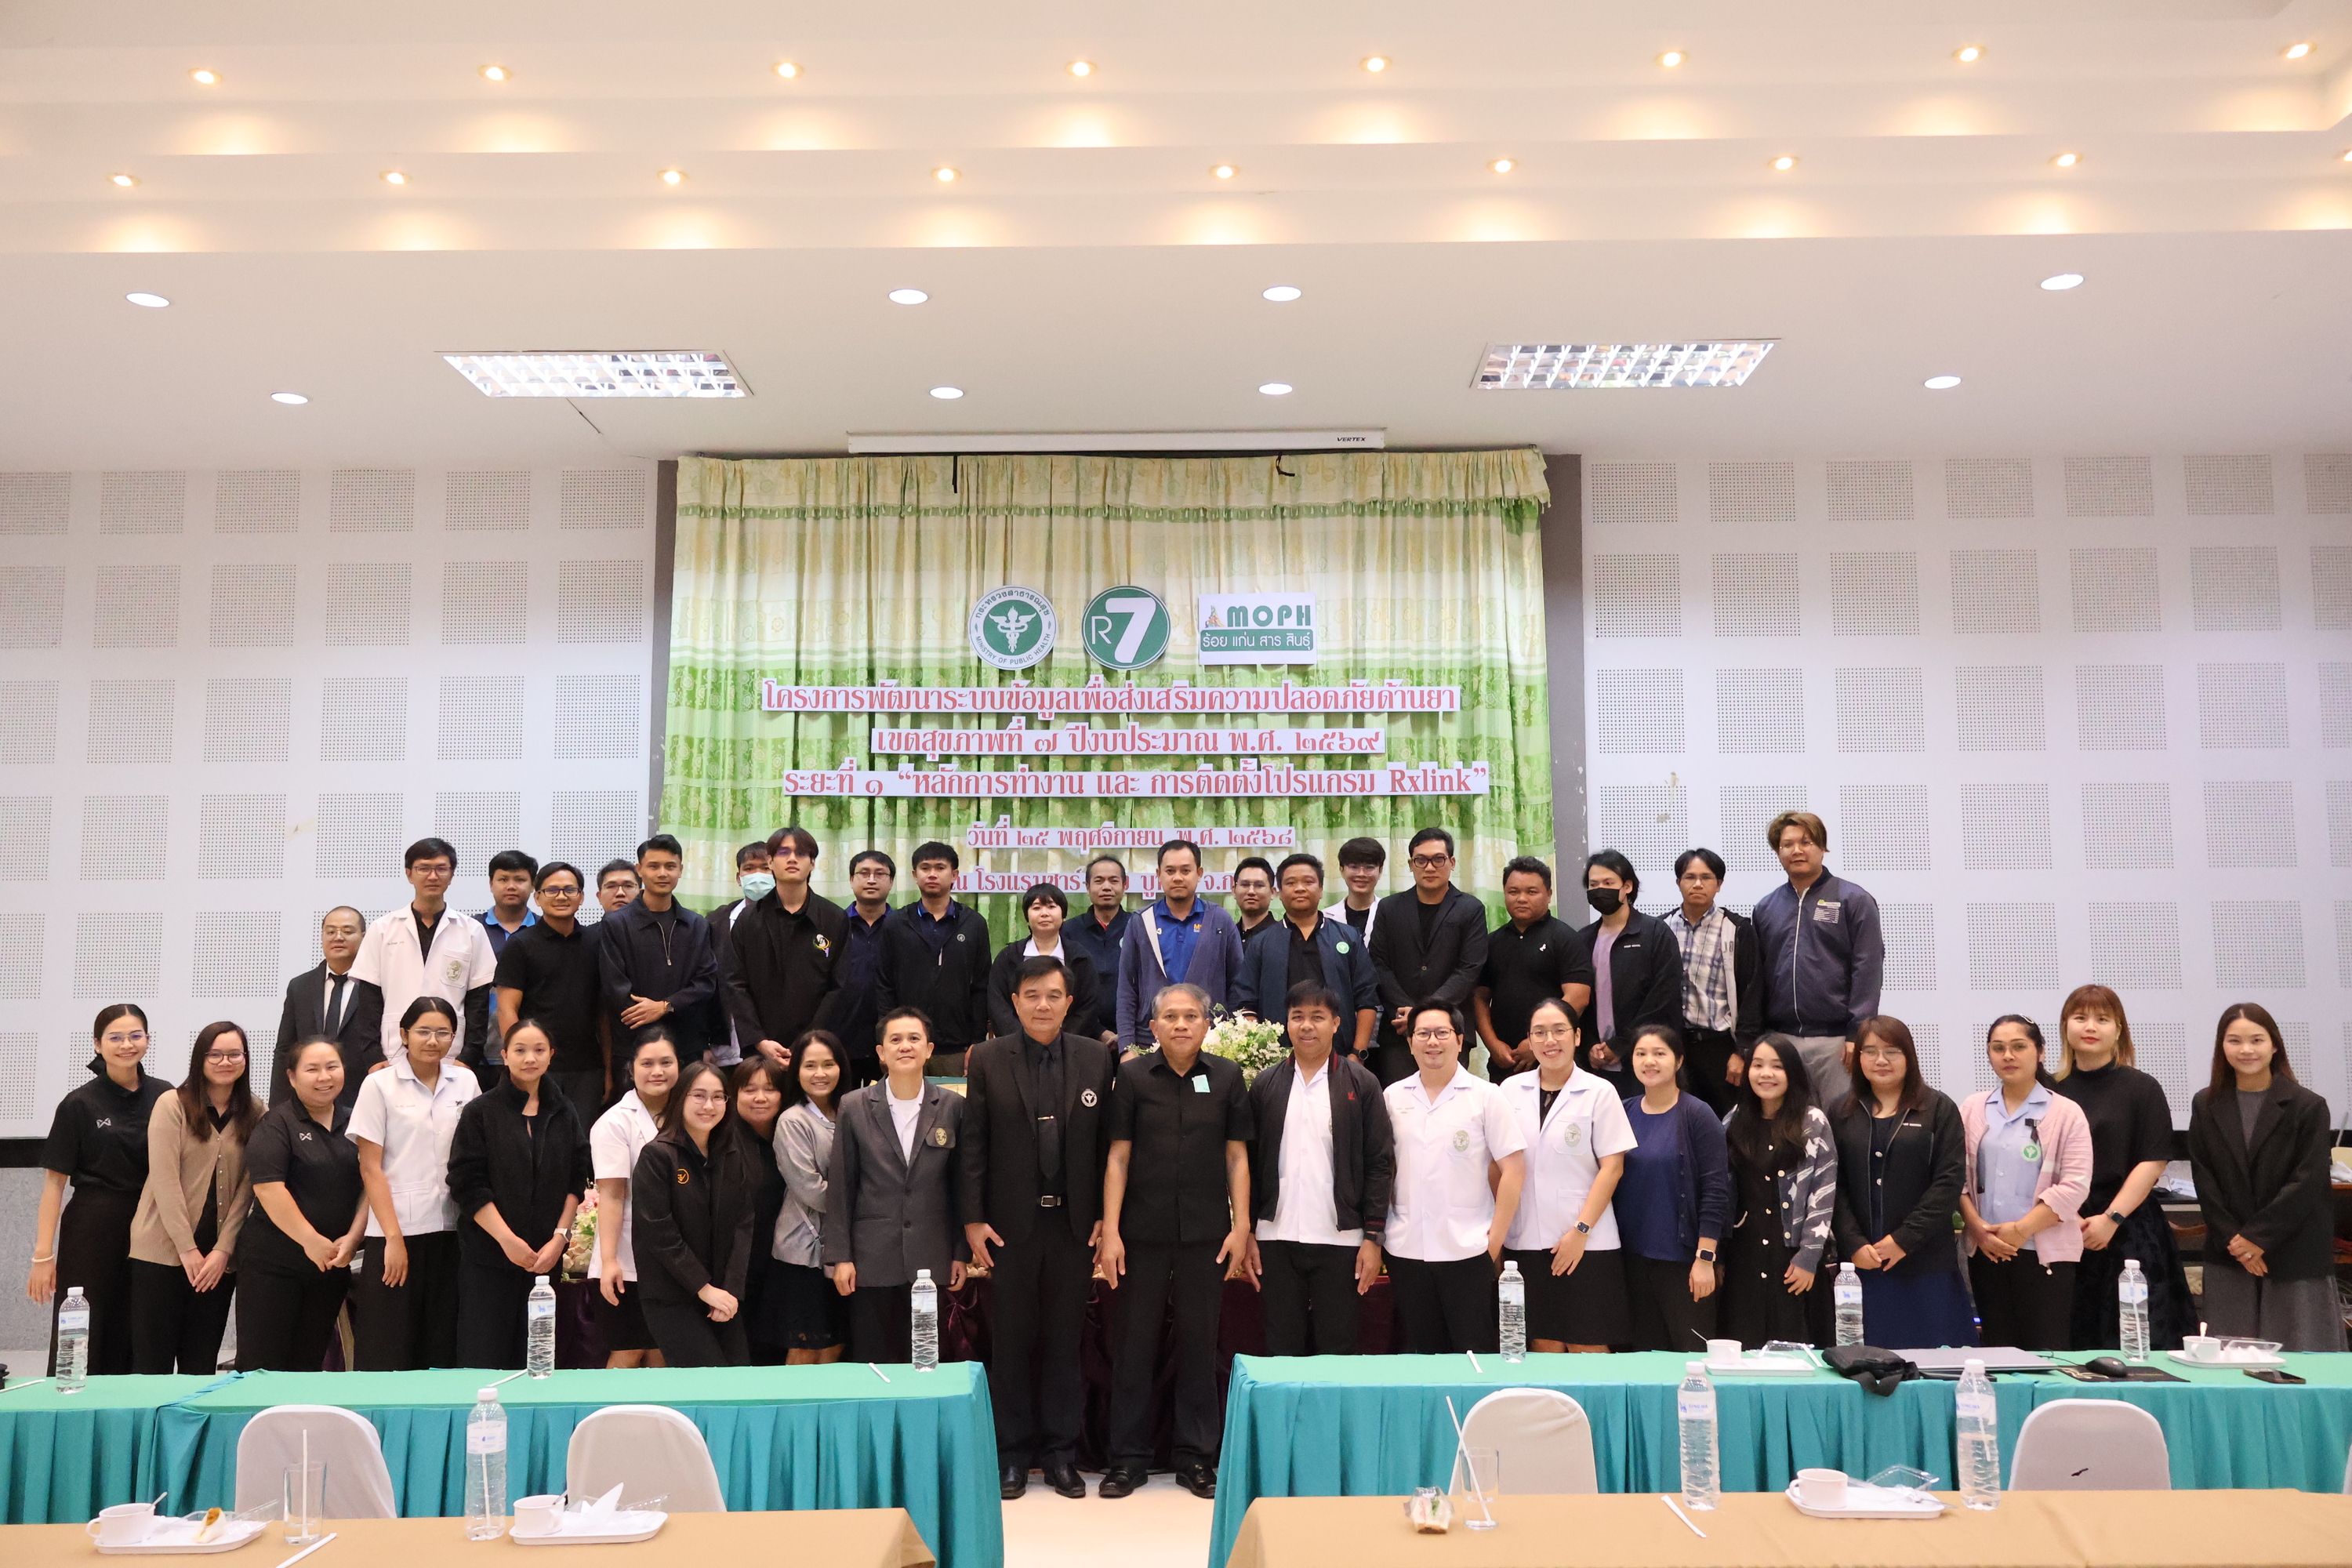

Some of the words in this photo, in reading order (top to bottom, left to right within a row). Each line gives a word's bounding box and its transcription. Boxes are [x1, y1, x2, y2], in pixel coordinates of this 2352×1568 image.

[1227, 604, 1311, 627] MOPH
[975, 636, 996, 660] MINISTRY
[1009, 654, 1033, 665] PUBLIC
[1033, 633, 1051, 656] HEALTH
[1203, 632, 1228, 648] ร้อย
[1232, 631, 1254, 647] แก่น
[1260, 635, 1282, 647] สาร
[1287, 632, 1311, 650] สินธุ์
[764, 677, 1455, 720] โครงการพัฒนาระบบข้อมูลเพื่อส่งเสริมความปลอดภัยด้านยา
[878, 718, 1023, 759] เขตสุขภาพที่
[1034, 739, 1058, 752] ๗
[1067, 724, 1218, 752] ปีงบประมาณ
[1229, 730, 1282, 751] พ.ศ.
[1295, 731, 1380, 751] ๒๕๖๙
[785, 760, 855, 793] ระยะที่
[866, 780, 884, 795] ๑
[1098, 774, 1140, 793] และ
[1151, 760, 1375, 794] การติดตั้งโปรแกรม
[968, 818, 1008, 846] วันที่
[1017, 831, 1049, 846] ๒๕
[1058, 825, 1163, 851] พฤศจิกายน
[1229, 829, 1292, 845] ๒๕๖๘
